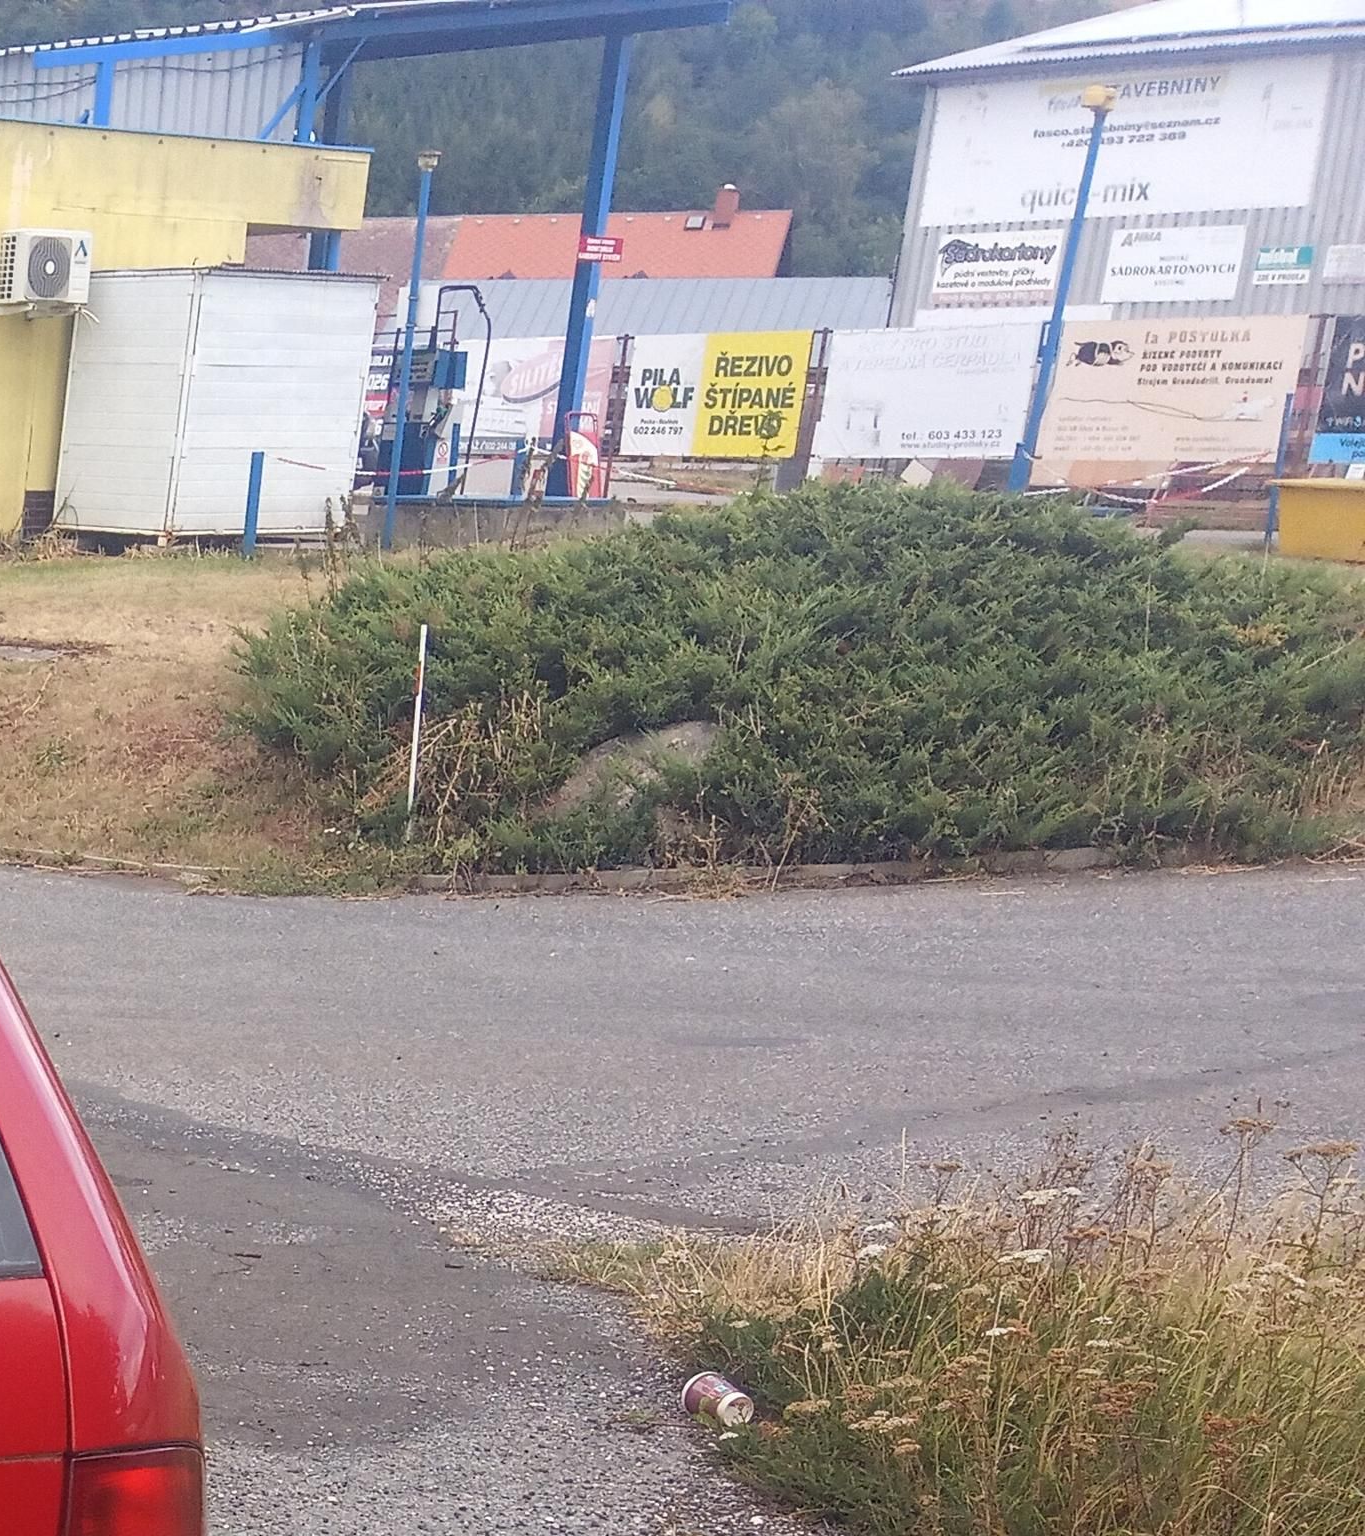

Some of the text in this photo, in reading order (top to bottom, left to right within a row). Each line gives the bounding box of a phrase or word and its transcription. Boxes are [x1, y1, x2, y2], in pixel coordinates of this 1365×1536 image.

[1106, 77, 1221, 99] TAVEBNINY
[1021, 177, 1150, 213] quic-mix
[714, 352, 793, 378] ŘEZIVO
[641, 367, 681, 387] PILA
[704, 382, 796, 409] ŠTÍPANÉ
[633, 426, 649, 435] 602
[668, 426, 684, 435] 797
[928, 430, 951, 440] 603
[954, 430, 977, 440] 433
[980, 429, 1003, 439] 123
